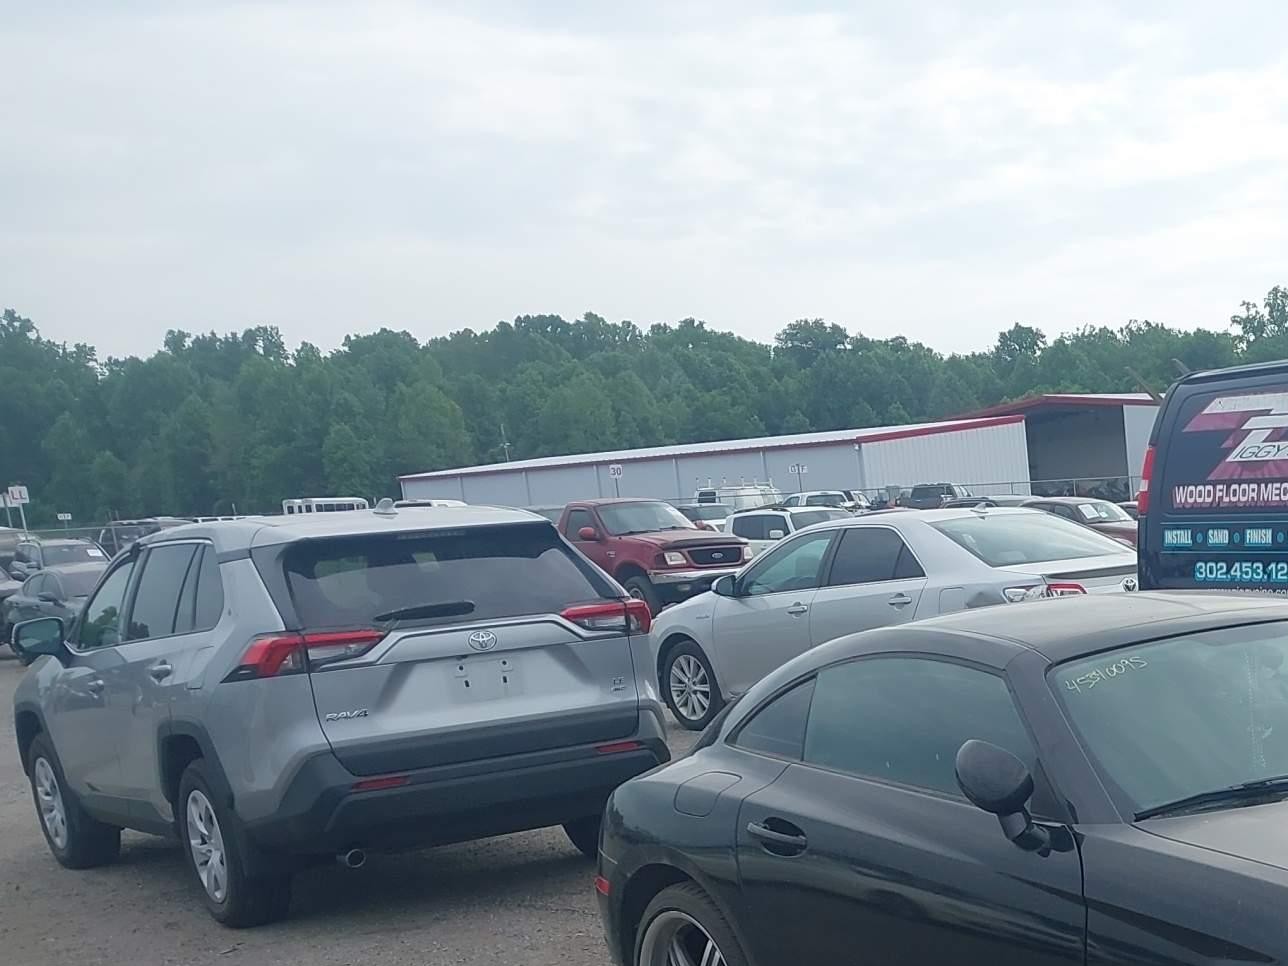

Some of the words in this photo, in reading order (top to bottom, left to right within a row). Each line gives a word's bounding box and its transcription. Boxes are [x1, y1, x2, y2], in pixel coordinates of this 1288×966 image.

[610, 467, 621, 476] 30
[1174, 483, 1214, 504] WOOD
[1216, 482, 1258, 503] FLOOR
[1164, 529, 1192, 545] INSTALL
[1207, 529, 1229, 544] SAND
[1246, 528, 1272, 544] FINISH
[326, 708, 368, 721] RAV4
